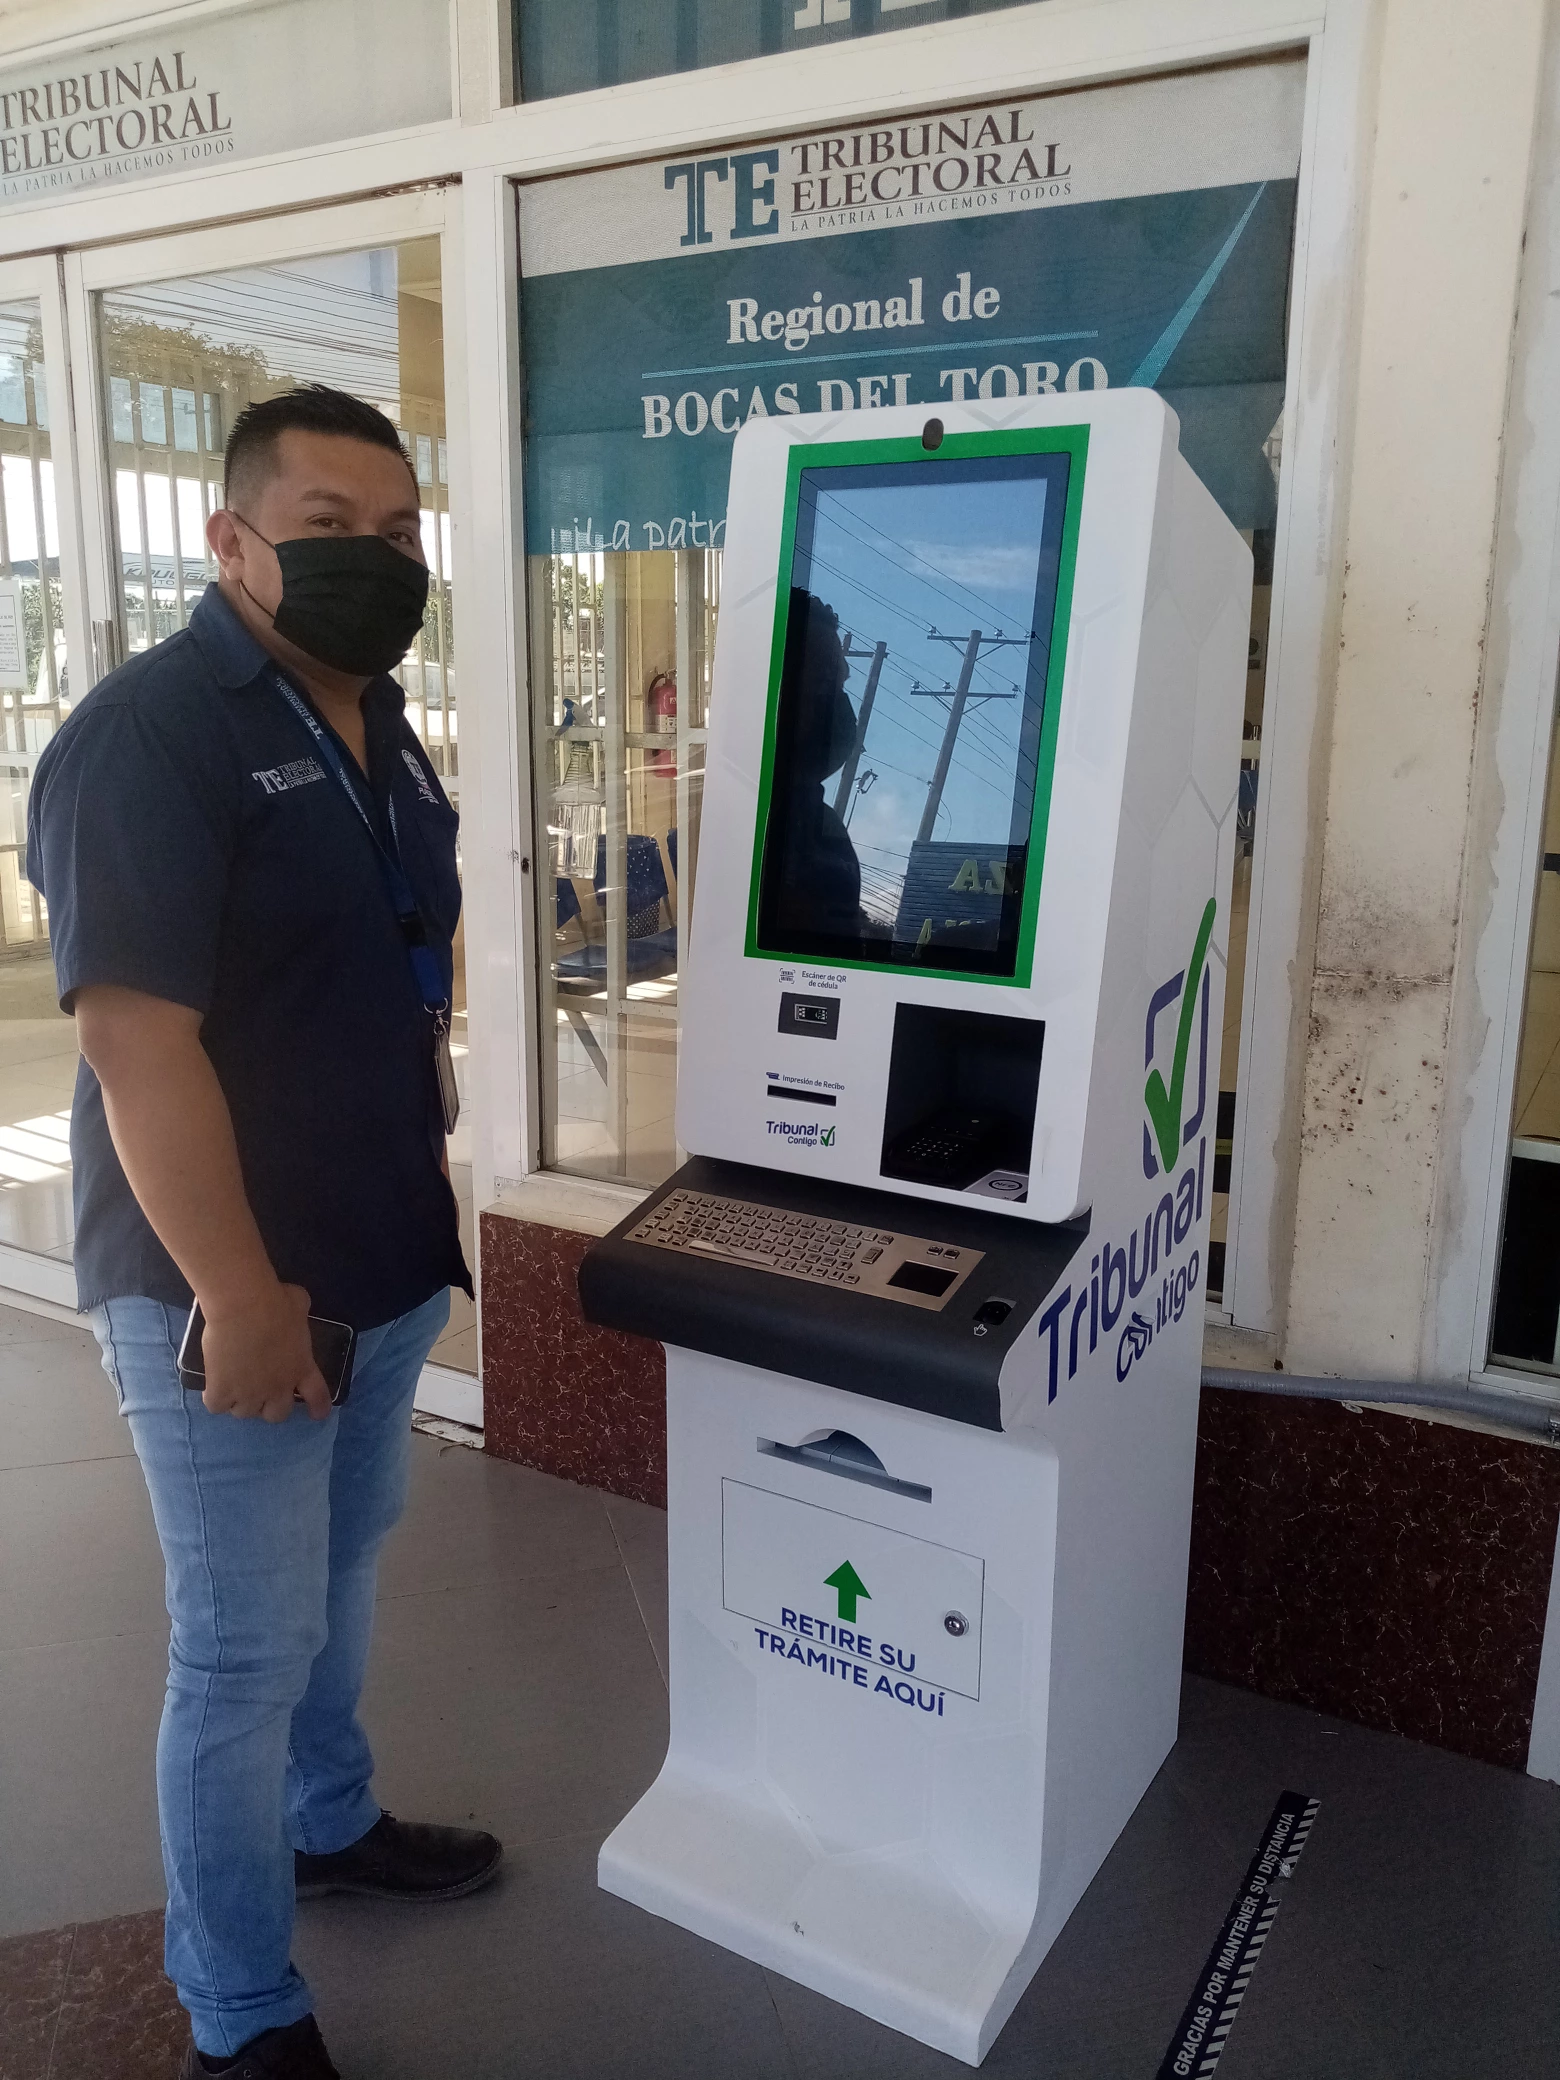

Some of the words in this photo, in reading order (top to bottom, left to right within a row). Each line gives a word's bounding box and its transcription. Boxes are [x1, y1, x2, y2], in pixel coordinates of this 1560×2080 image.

[0, 51, 196, 131] TRIBUNAL
[0, 92, 232, 175] ELECTORAL
[791, 109, 1034, 175] TRIBUNAL
[3, 182, 19, 196] LA
[26, 169, 73, 192] PATRIA
[80, 166, 97, 181] LA
[104, 150, 174, 177] HACEMOS
[182, 138, 234, 161] TODOS
[664, 149, 779, 247] TE
[791, 143, 1071, 214] ELECTORAL
[791, 215, 810, 232] LA
[818, 209, 875, 229] PATRIA
[885, 204, 904, 219] LA
[914, 192, 998, 215] HACEMOS
[1008, 183, 1071, 204] TODOS
[726, 277, 924, 351] Regional
[942, 271, 1000, 323] de
[641, 382, 801, 439] BOCAS
[817, 373, 923, 412] DEL
[940, 357, 1109, 402] TORO
[642, 510, 727, 551] patr
[252, 769, 289, 794] TE
[277, 756, 317, 773] TRIBUNAL
[801, 970, 826, 980] Escáner
[836, 975, 847, 983] QR
[817, 980, 838, 989] cédula
[782, 1075, 813, 1086] Impresión
[823, 1081, 845, 1091] Recibo
[766, 1121, 818, 1136] Tribunal
[787, 1136, 817, 1147] Contigo
[1038, 1136, 1206, 1406] Tribunal
[782, 1607, 872, 1658] RETIRE
[879, 1643, 916, 1672] SU
[755, 1628, 868, 1688] TRÁMITE
[874, 1675, 946, 1716] AQUÍ
[1258, 1812, 1295, 1875] DISTANCIA
[1250, 1876, 1267, 1894] SU
[1216, 1895, 1259, 1970] MANTENER
[1203, 1971, 1228, 2004] POR
[1173, 2005, 1212, 2076] GRACIAS
